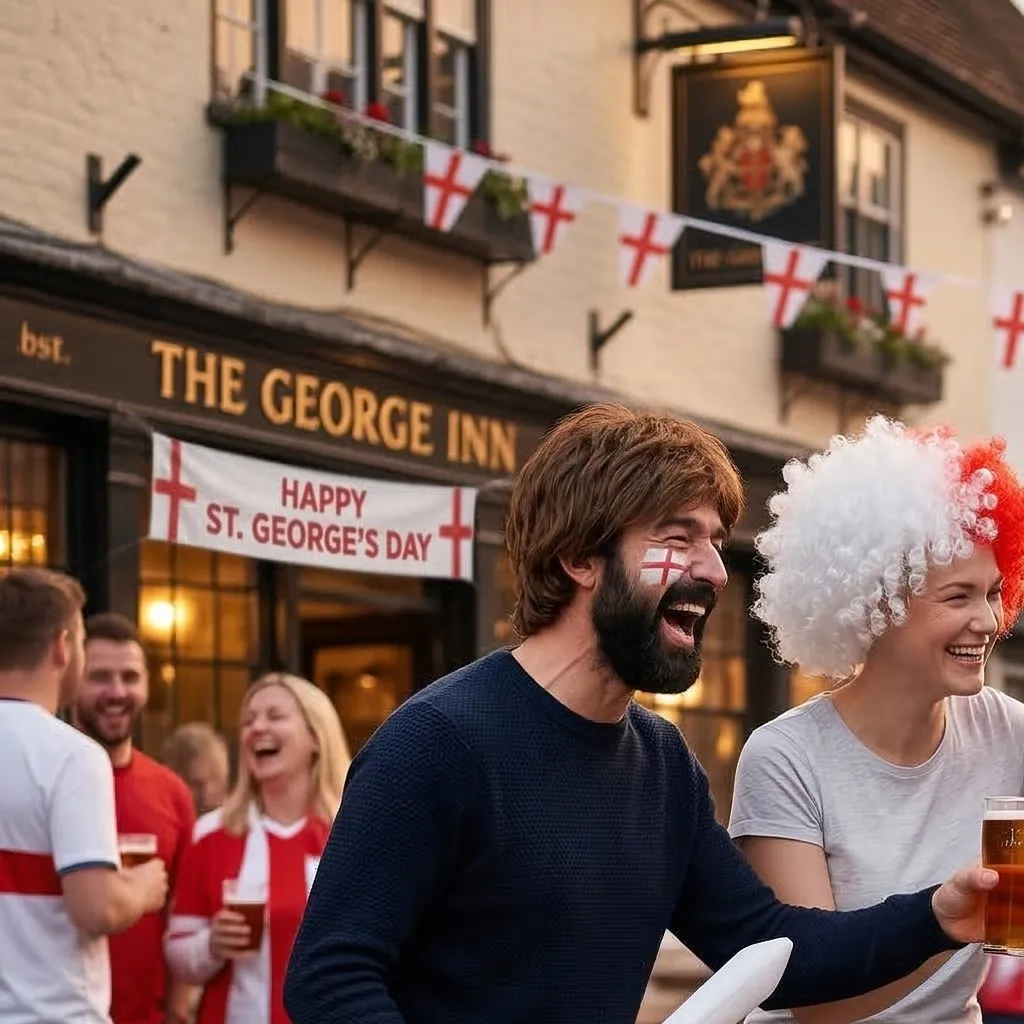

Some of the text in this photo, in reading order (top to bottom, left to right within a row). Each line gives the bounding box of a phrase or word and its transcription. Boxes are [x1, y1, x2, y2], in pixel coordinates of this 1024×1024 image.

[151, 341, 517, 472] THE GEORGE INN
[281, 477, 367, 518] HAPPY
[206, 503, 432, 562] ST. GEORGE'S DAY
